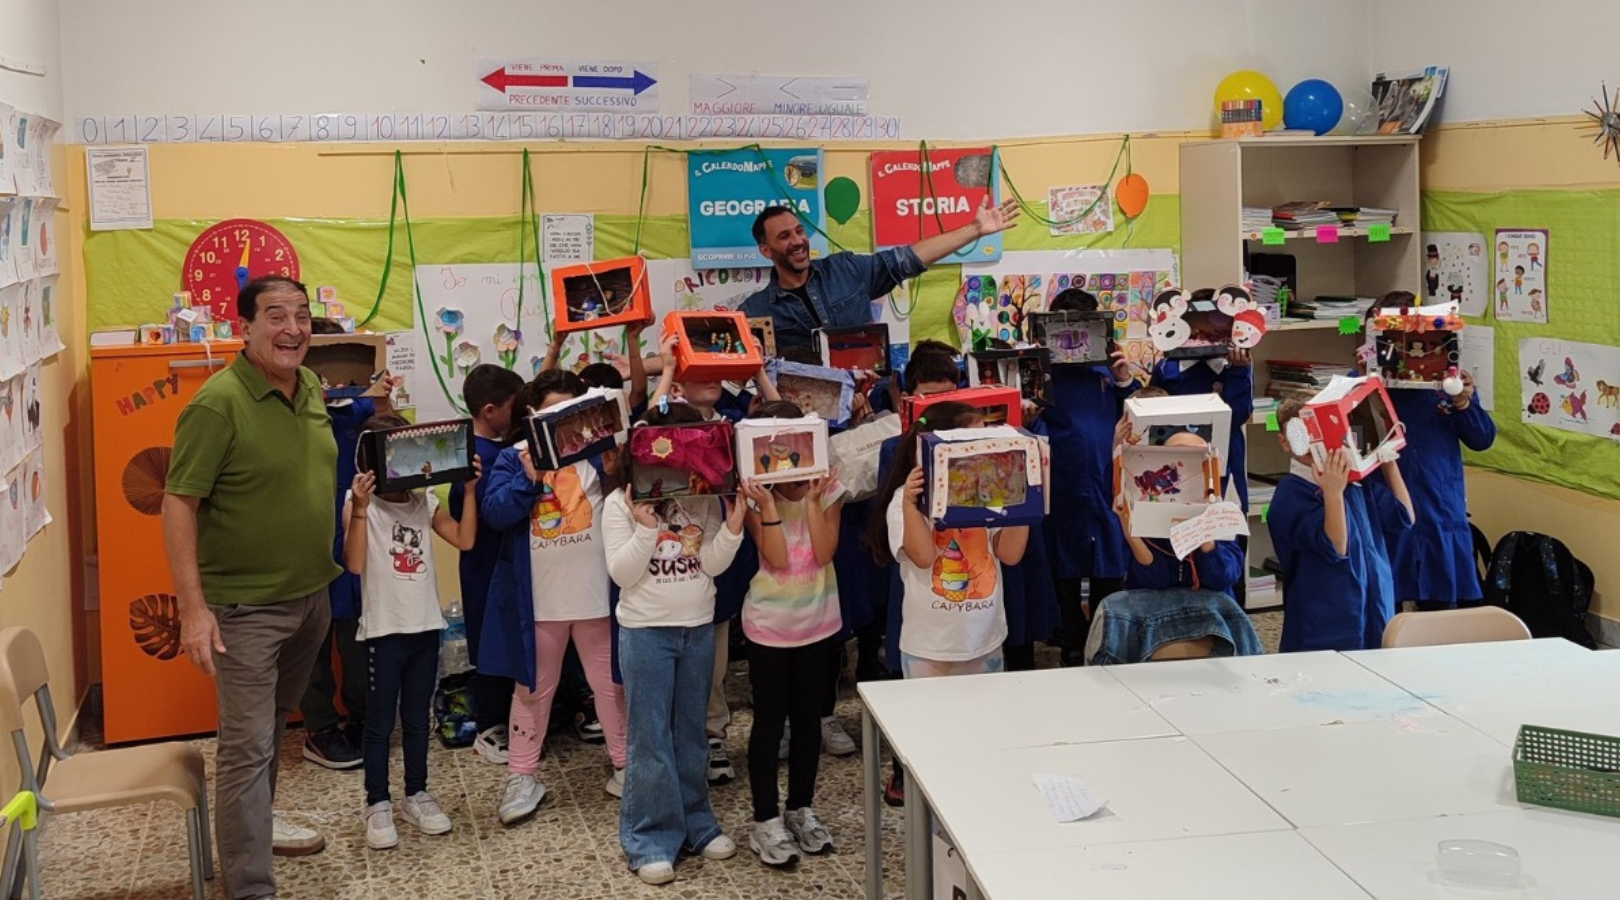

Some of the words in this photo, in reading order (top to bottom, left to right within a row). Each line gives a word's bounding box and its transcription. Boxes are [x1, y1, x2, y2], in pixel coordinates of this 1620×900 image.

[510, 64, 534, 72] VIENE
[540, 64, 565, 72] PRIMA
[578, 65, 599, 73] VIENE
[508, 94, 570, 106] PRECEDENTE
[575, 95, 638, 107] SUCCESSIVO
[693, 102, 758, 115] MAGGIORE
[773, 102, 814, 115] MINORE
[818, 103, 864, 115] UGUALE
[82, 117, 98, 143] 0
[113, 118, 125, 141] 1
[142, 117, 158, 142] 2
[173, 116, 189, 141] 3
[199, 117, 221, 141] 4
[230, 117, 245, 140] 5
[258, 116, 274, 140] 6
[287, 116, 303, 140] 7
[316, 116, 329, 140] 8
[345, 116, 357, 139] 9
[372, 115, 393, 138] 10
[400, 115, 419, 138] 11
[425, 116, 448, 138] 12
[460, 115, 481, 138] 13
[487, 115, 507, 138] 14
[513, 115, 533, 138] 15
[540, 115, 560, 138] 16
[566, 115, 586, 137] 17
[593, 115, 612, 138] 18
[618, 115, 636, 138] 19
[640, 116, 663, 138] 20
[664, 116, 682, 138] 21
[688, 116, 711, 138] 22
[713, 116, 736, 138] 23
[761, 116, 782, 138] 25
[783, 116, 806, 138] 26
[808, 116, 830, 138] 27
[832, 117, 853, 138] 28
[854, 117, 873, 138] 29
[878, 117, 897, 138] 30
[896, 196, 971, 216] STORIA
[233, 229, 250, 242] 12
[259, 235, 266, 247] 1
[213, 236, 228, 248] 11
[199, 252, 216, 264] 10
[275, 249, 284, 261] 2
[194, 269, 203, 282] 9
[281, 266, 290, 278] 3
[202, 289, 211, 301] 8
[219, 302, 228, 314] 7
[1538, 340, 1562, 355] GLI
[116, 373, 179, 416] HAPPY
[531, 533, 593, 551] CAPYBARA
[931, 600, 994, 612] CAPYBARA
